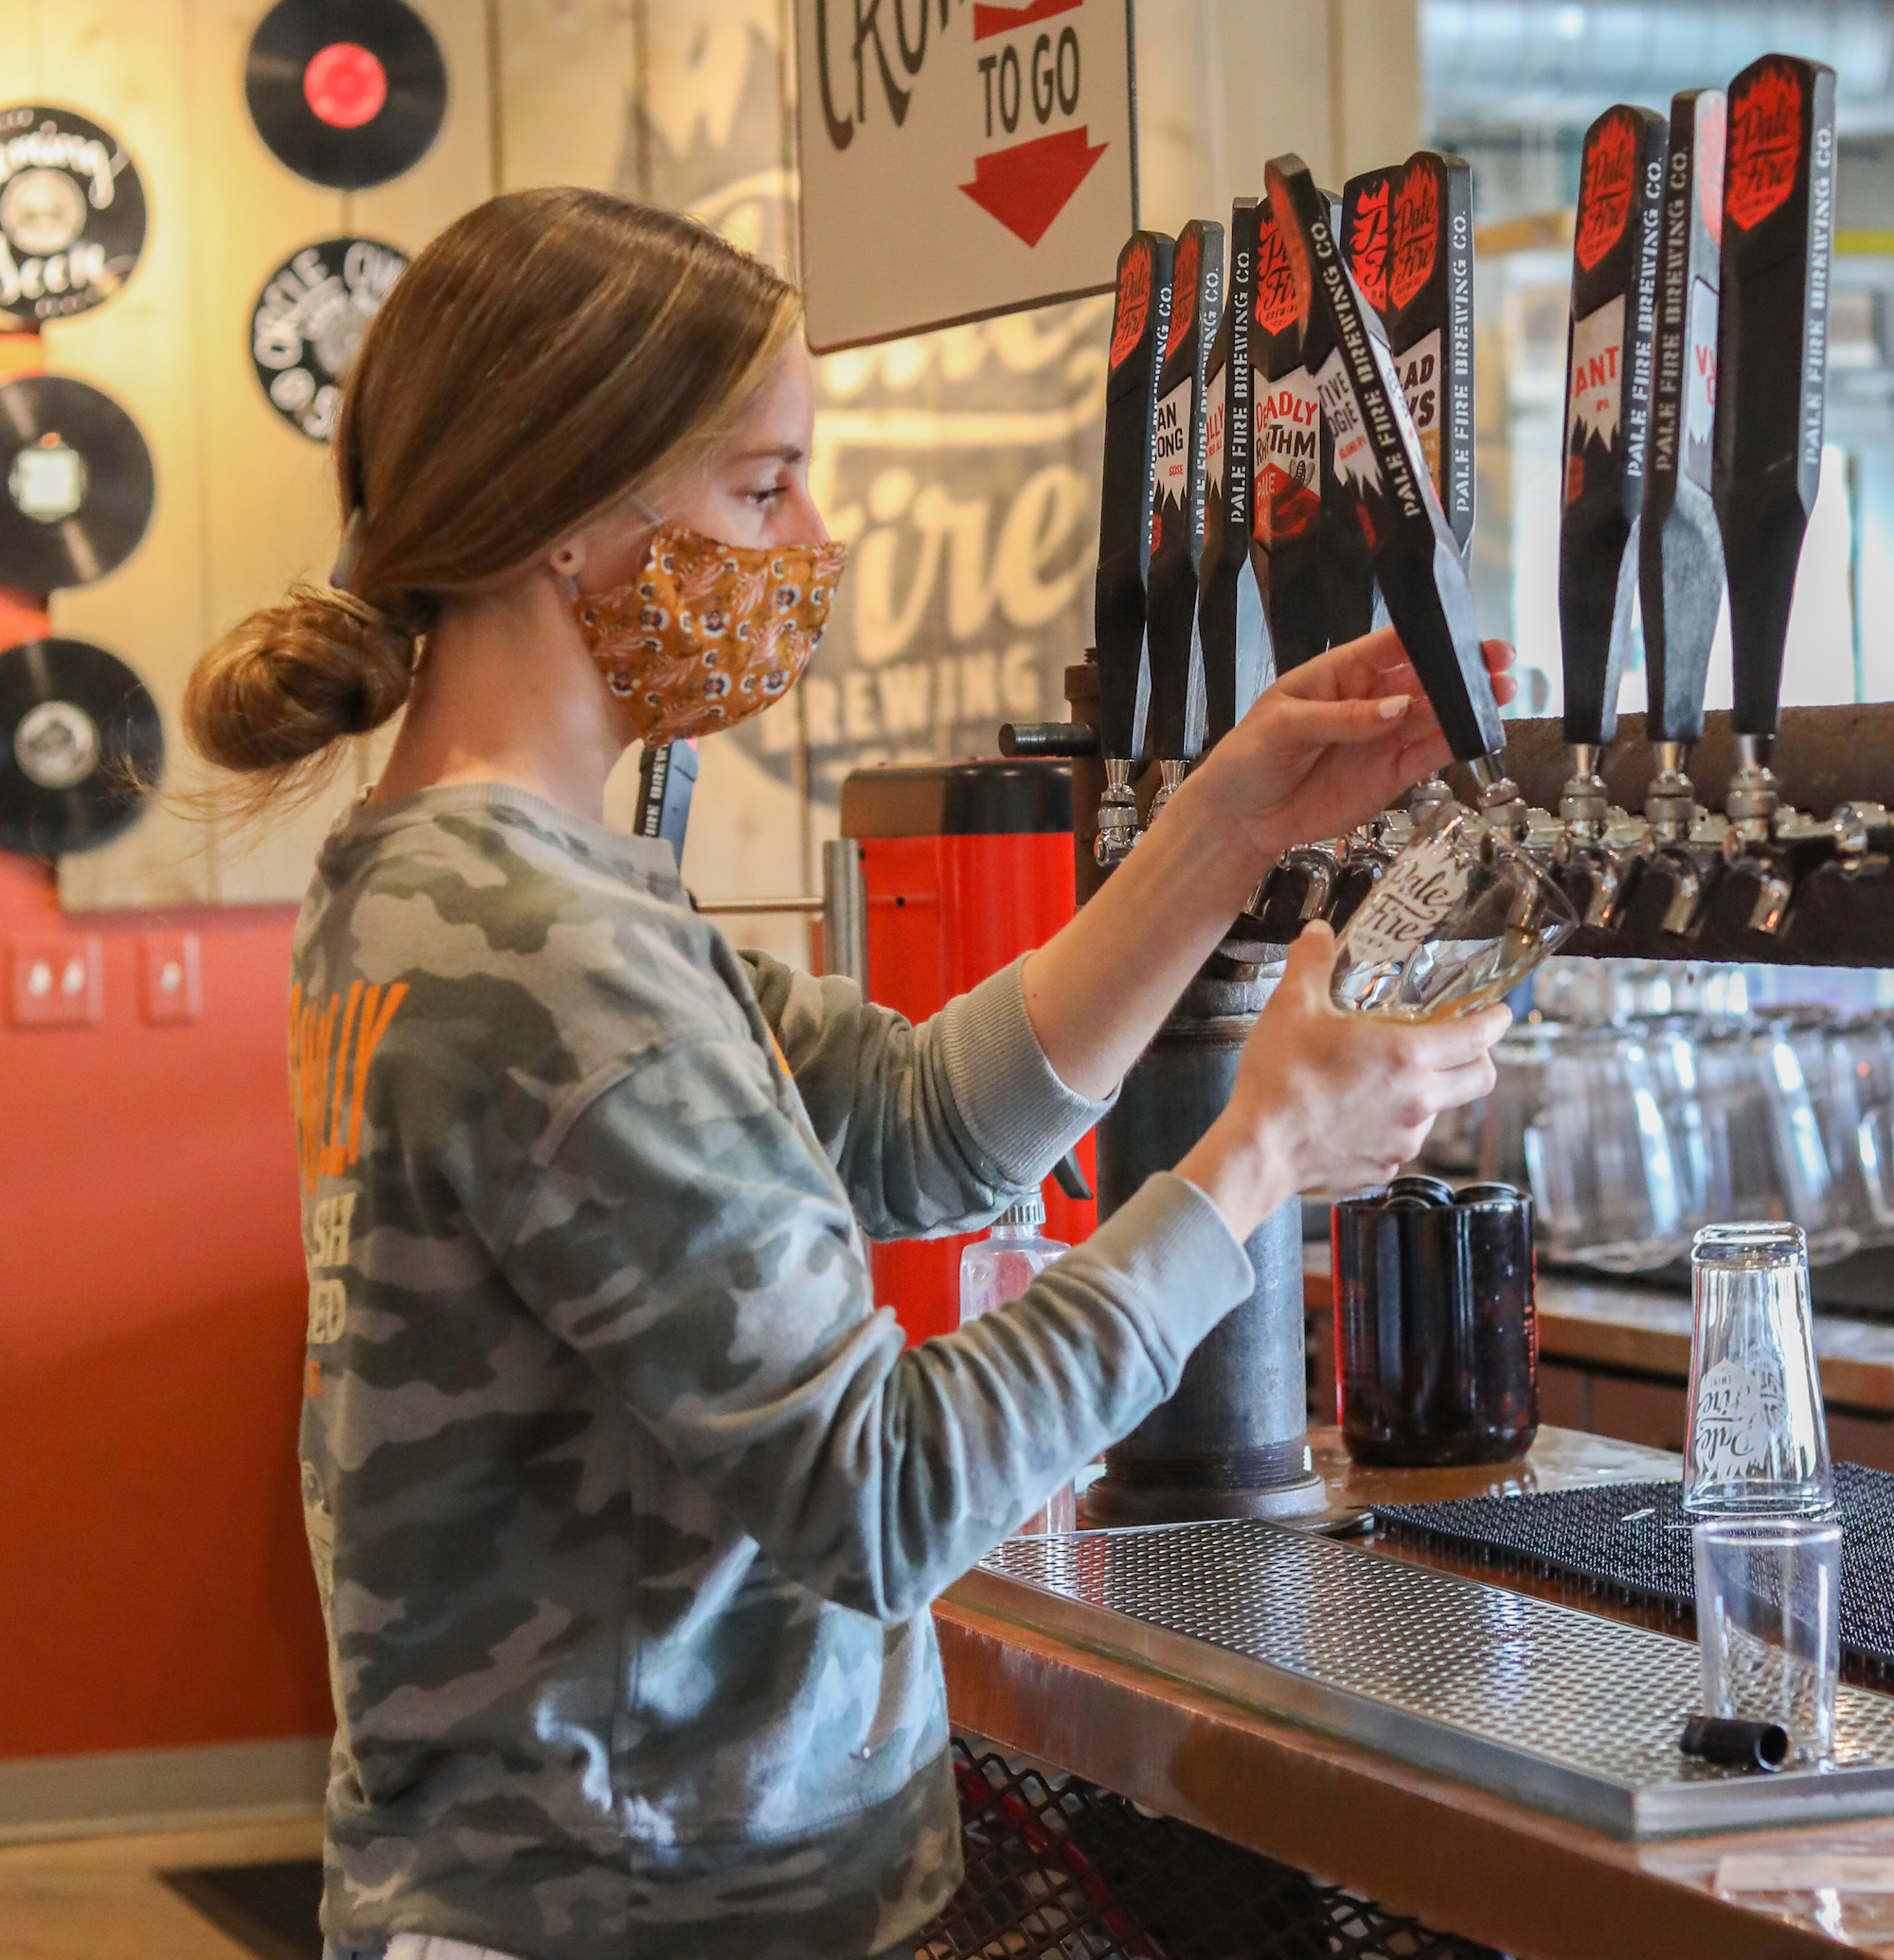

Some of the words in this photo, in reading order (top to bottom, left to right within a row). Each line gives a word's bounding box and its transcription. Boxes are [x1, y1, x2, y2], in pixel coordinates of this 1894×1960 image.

[978, 44, 1022, 138] TO
[1031, 26, 1081, 125] GO
[1645, 157, 1663, 200] CO.
[1453, 210, 1467, 250] CO.
[1810, 177, 1831, 311] BREWING
[1205, 268, 1220, 303] CO.
[1637, 207, 1658, 332] BREWING
[1665, 199, 1685, 324] BREWING
[1158, 283, 1173, 317] CO.
[1322, 264, 1373, 384] BREWING
[1455, 259, 1469, 376] BREWING
[1233, 292, 1249, 399] BREWING
[1632, 341, 1652, 401] FIRE
[1660, 334, 1680, 393] FIRE
[1806, 319, 1825, 383] FIRE
[1232, 407, 1247, 456] FIRE
[1256, 390, 1318, 434] DEADLY
[1364, 389, 1397, 448] FIRE
[1455, 384, 1469, 439] FIRE
[1654, 402, 1675, 471] PALE
[1805, 392, 1822, 465] PALE
[1169, 464, 1184, 476] GOSE
[1256, 423, 1316, 466] RHYTHM
[1627, 409, 1648, 477] PALE
[1231, 465, 1246, 523] PALE
[1257, 472, 1277, 507] PALE
[1385, 453, 1420, 518] PALE
[1455, 449, 1470, 512] PALE
